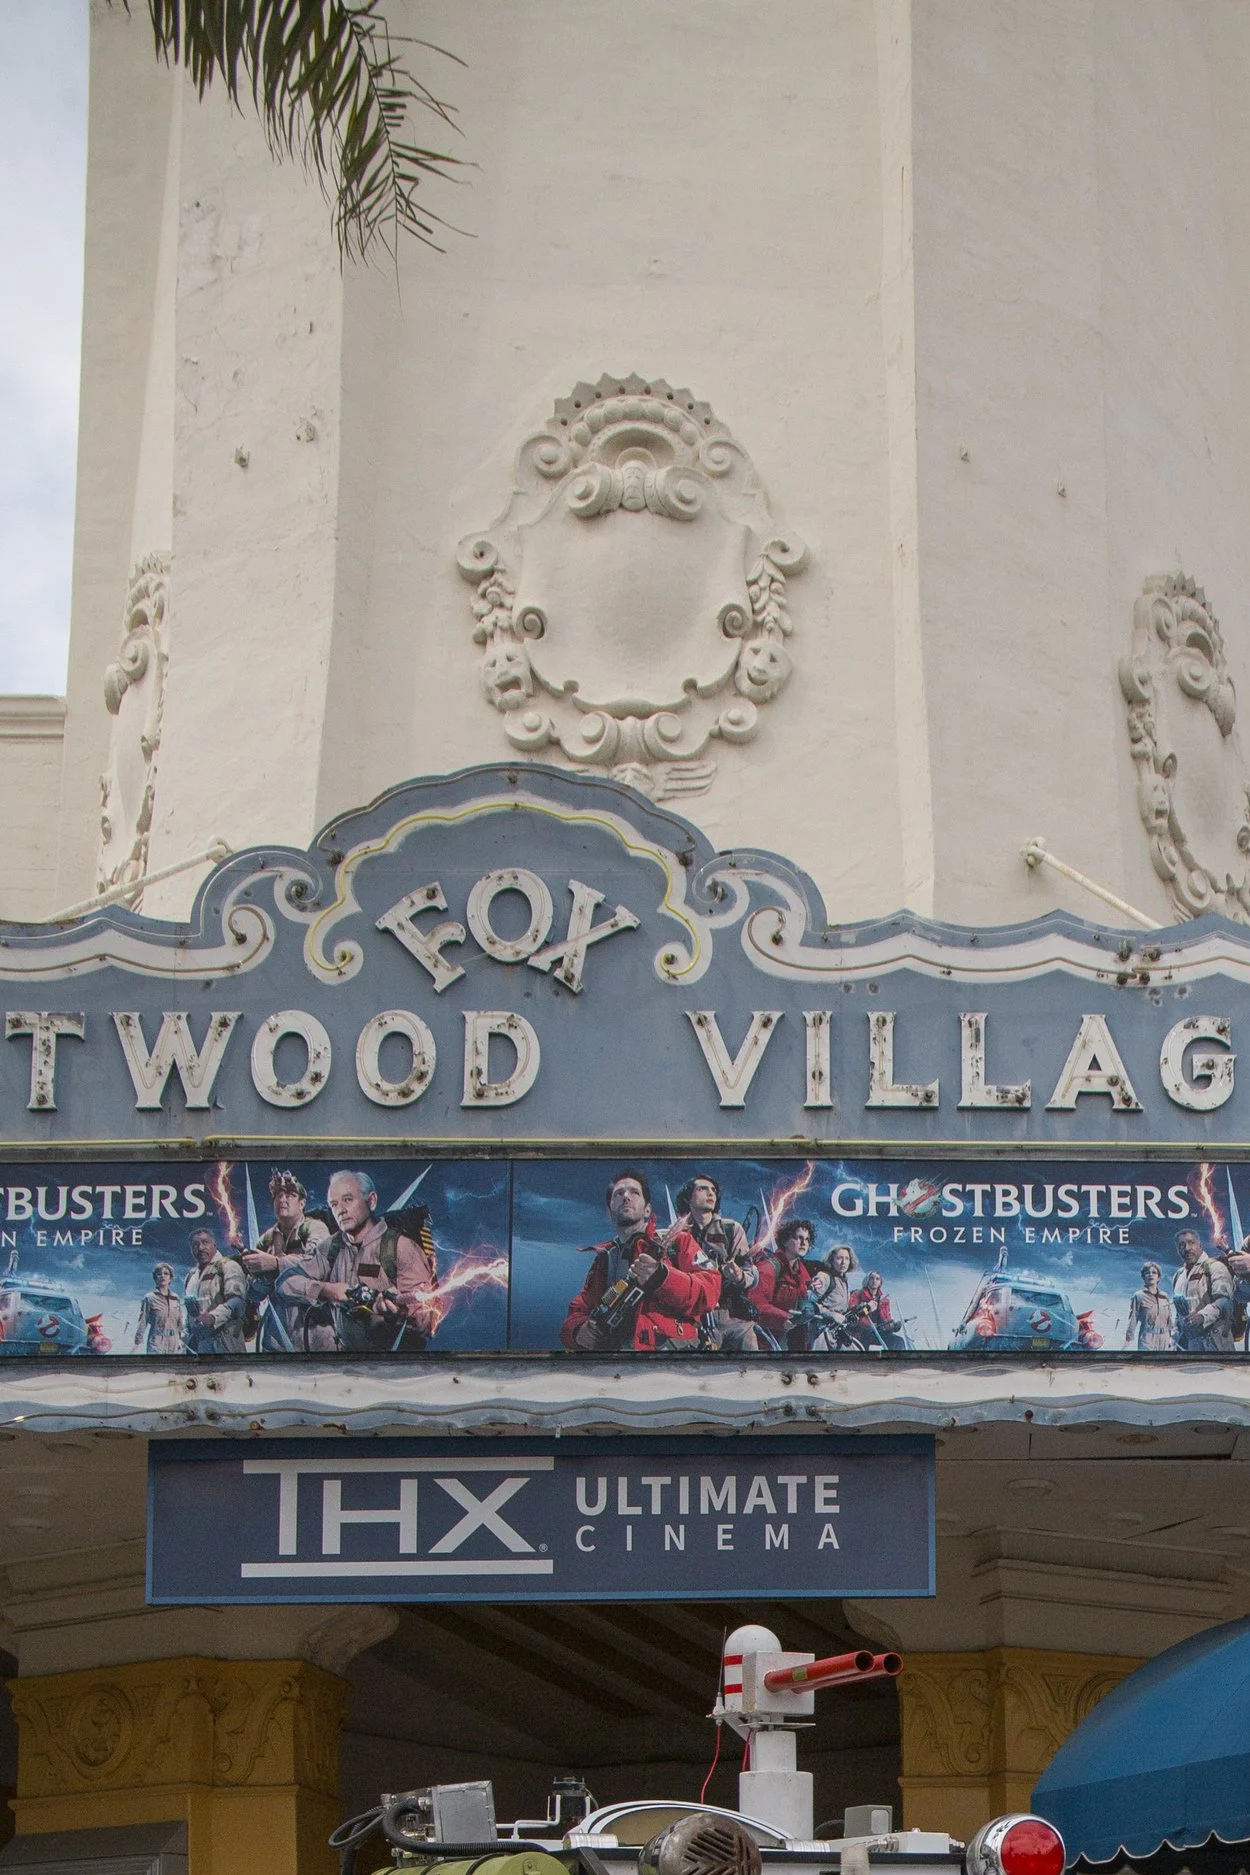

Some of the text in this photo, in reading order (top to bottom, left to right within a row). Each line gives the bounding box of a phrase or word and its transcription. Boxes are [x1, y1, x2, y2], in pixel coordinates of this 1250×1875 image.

[374, 866, 642, 993] FOX
[5, 1009, 541, 1111] TWOOD
[0, 1183, 206, 1222] BUSTERS
[831, 1180, 1191, 1221] GHOSTBUSTERS
[36, 1228, 143, 1248] EMPIRE
[892, 1225, 1131, 1245] FROZEN EMPIRE
[575, 1474, 842, 1517] ULTIMATE
[574, 1523, 841, 1552] CINEMA
